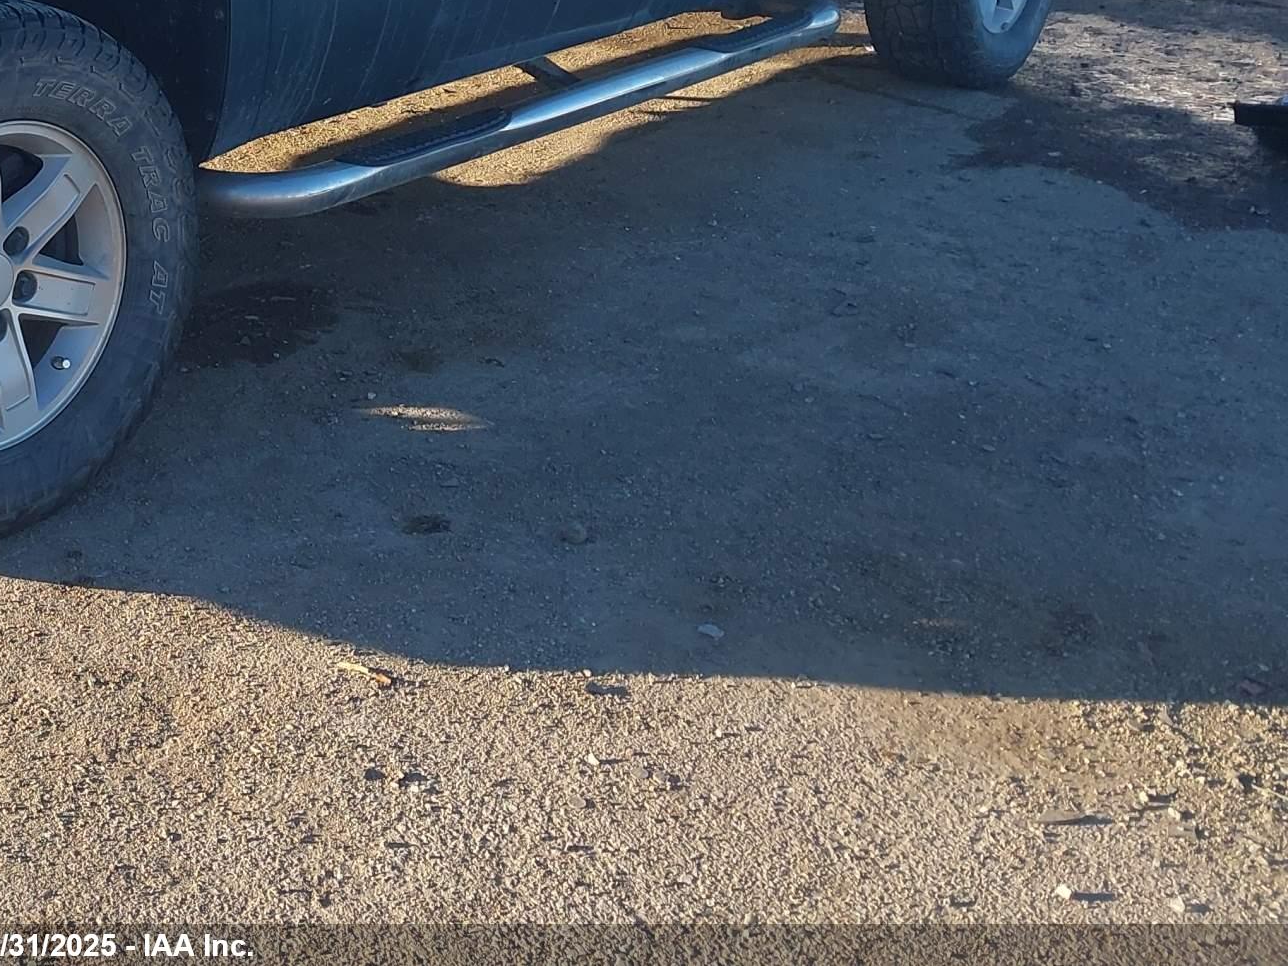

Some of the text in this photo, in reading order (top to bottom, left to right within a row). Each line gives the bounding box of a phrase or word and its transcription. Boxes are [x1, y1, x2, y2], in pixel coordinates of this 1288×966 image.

[31, 77, 133, 139] TERRA
[130, 144, 170, 243] TRAC
[148, 260, 170, 315] AT
